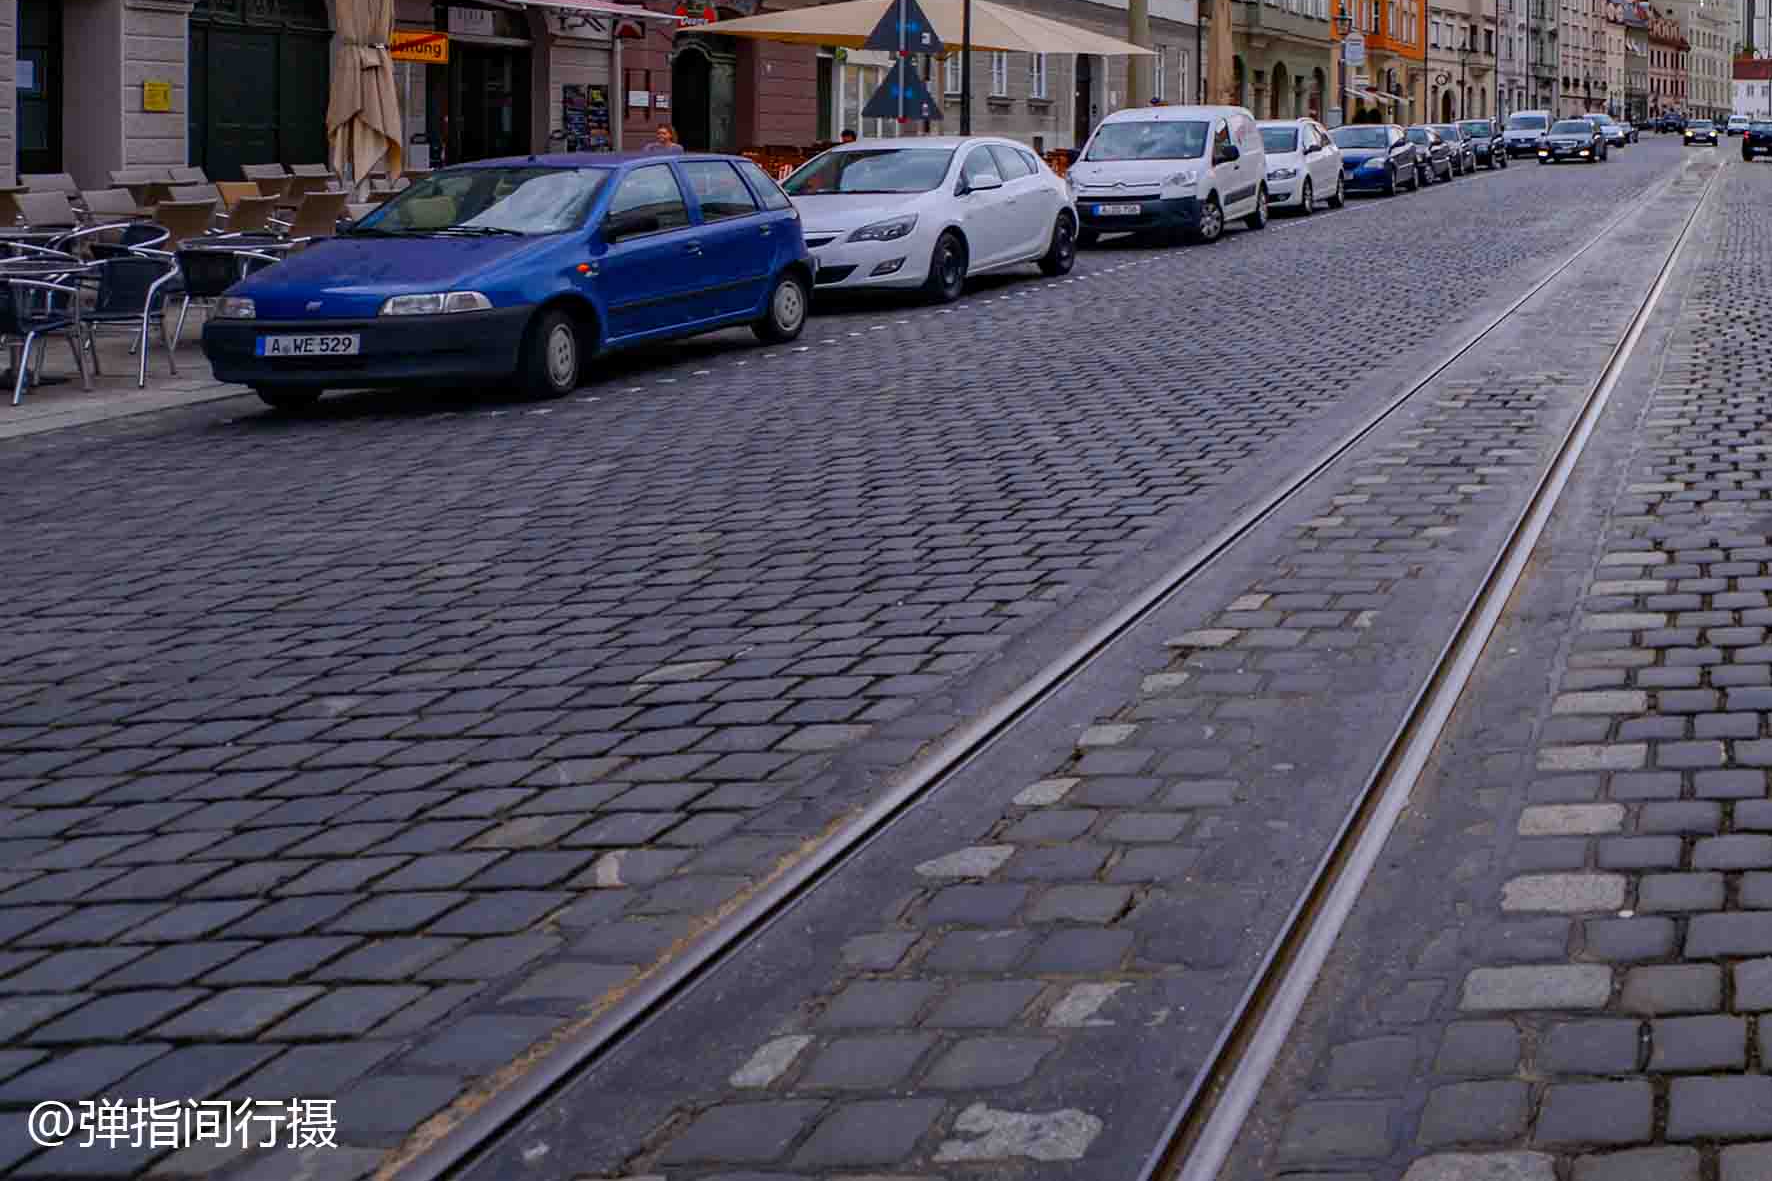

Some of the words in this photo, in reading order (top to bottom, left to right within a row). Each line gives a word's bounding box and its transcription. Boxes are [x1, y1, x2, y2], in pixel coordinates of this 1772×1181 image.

[272, 338, 281, 353] A
[293, 338, 313, 353] WE
[320, 337, 353, 353] 529
